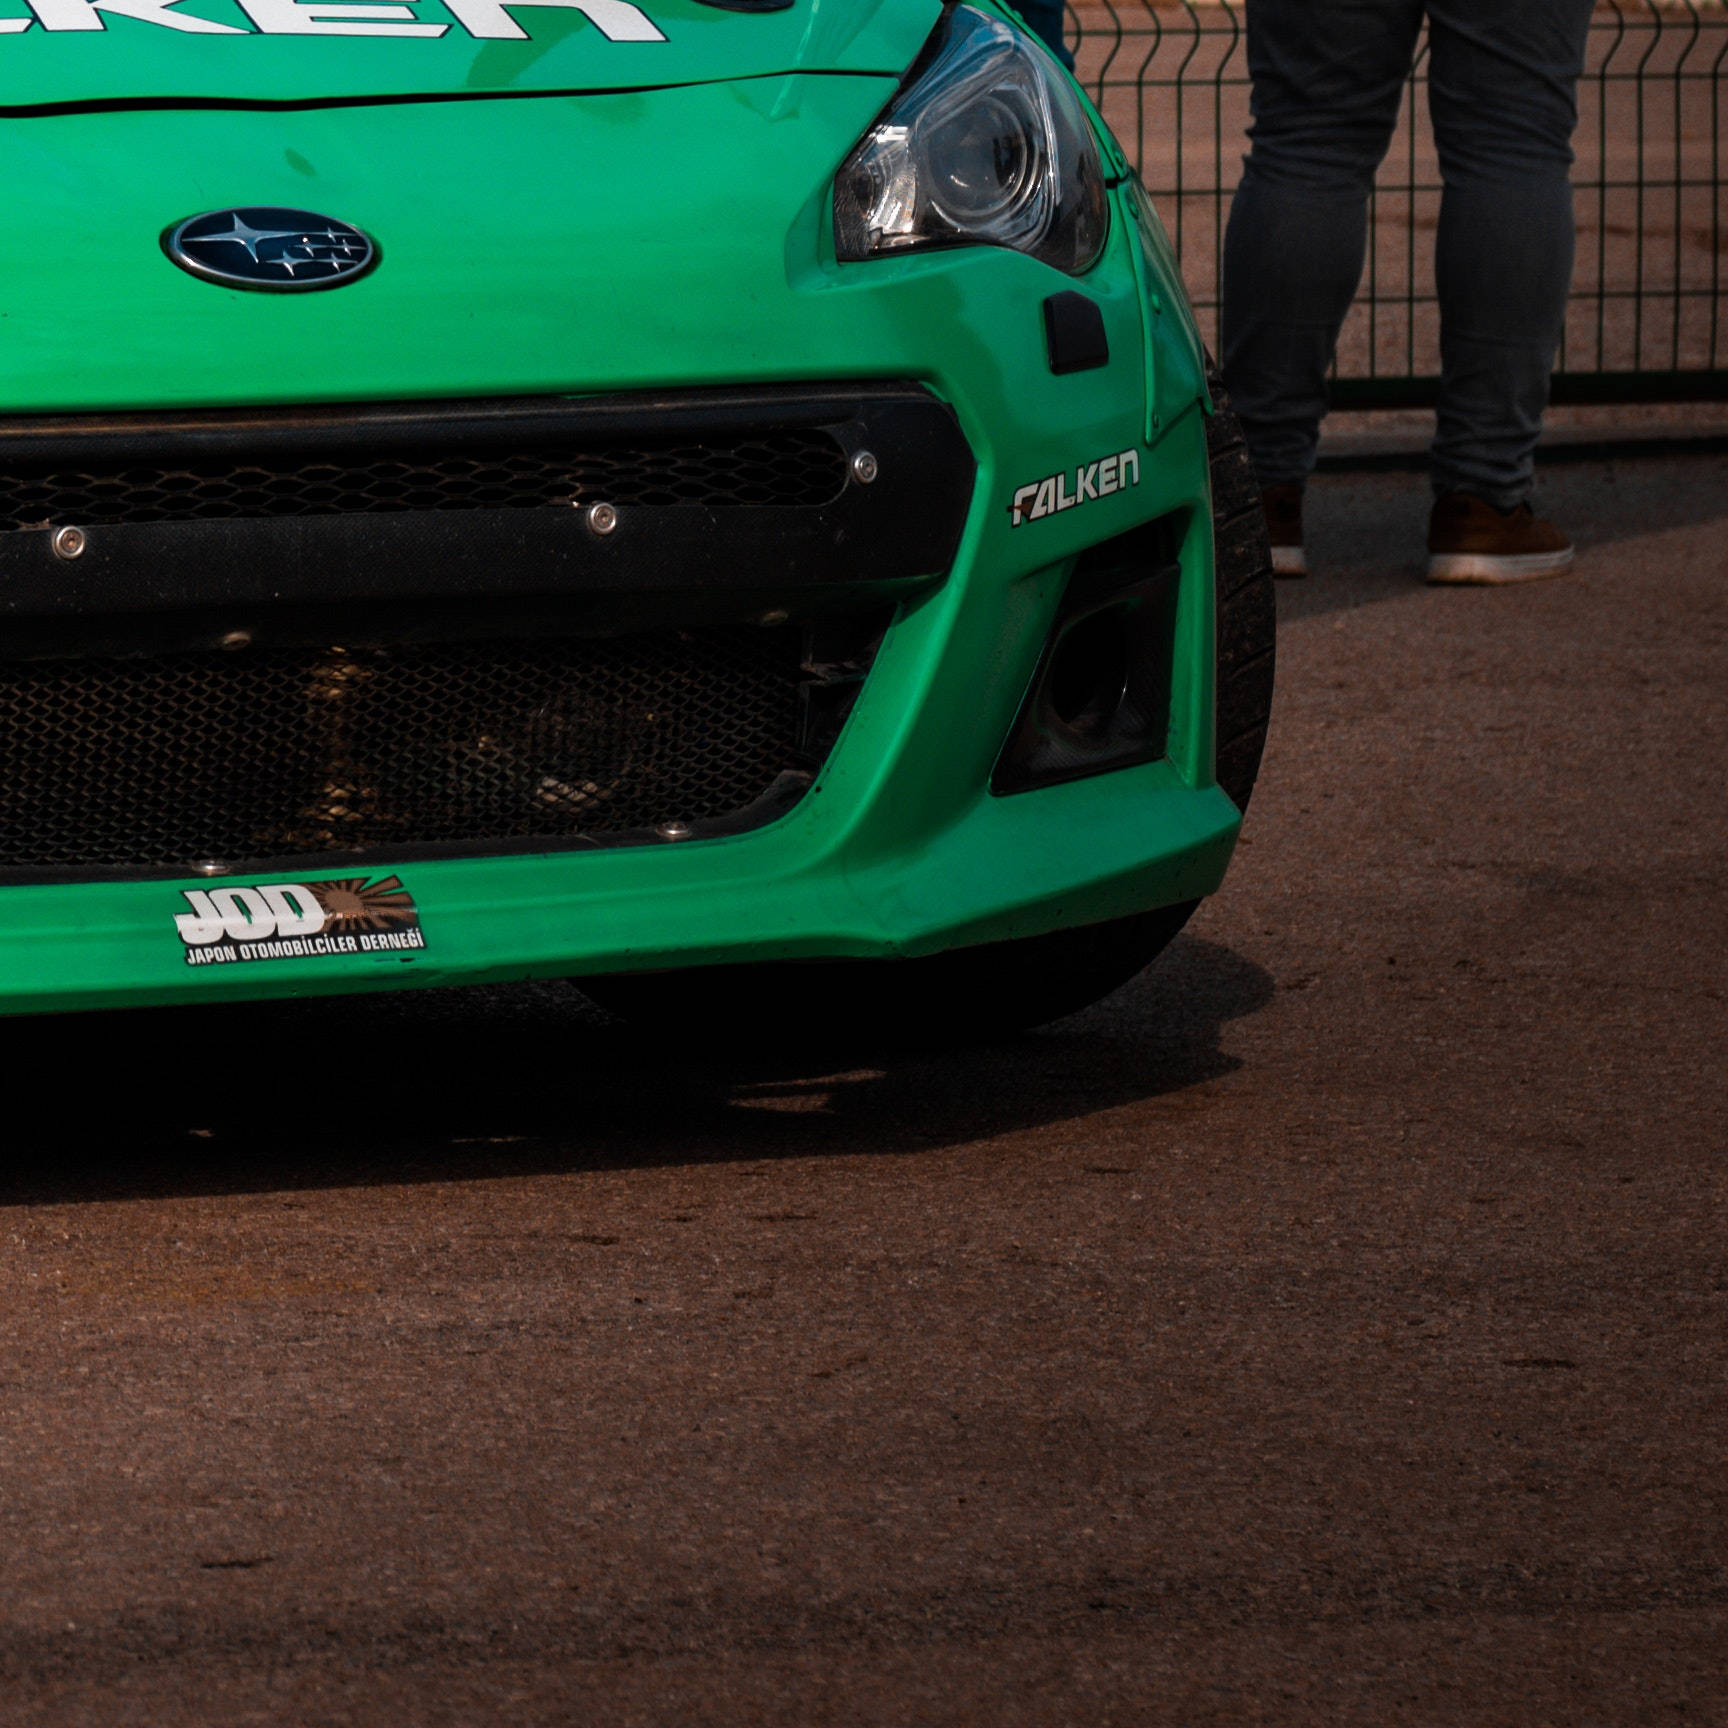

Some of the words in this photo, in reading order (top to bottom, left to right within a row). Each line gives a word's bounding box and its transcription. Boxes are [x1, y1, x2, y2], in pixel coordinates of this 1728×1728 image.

[1011, 448, 1141, 528] FALKEN
[174, 883, 325, 945] JOD
[187, 944, 238, 966] JAPON
[240, 934, 357, 961] OTOMOBİLCİLER
[362, 927, 425, 952] DERNEĞİ
